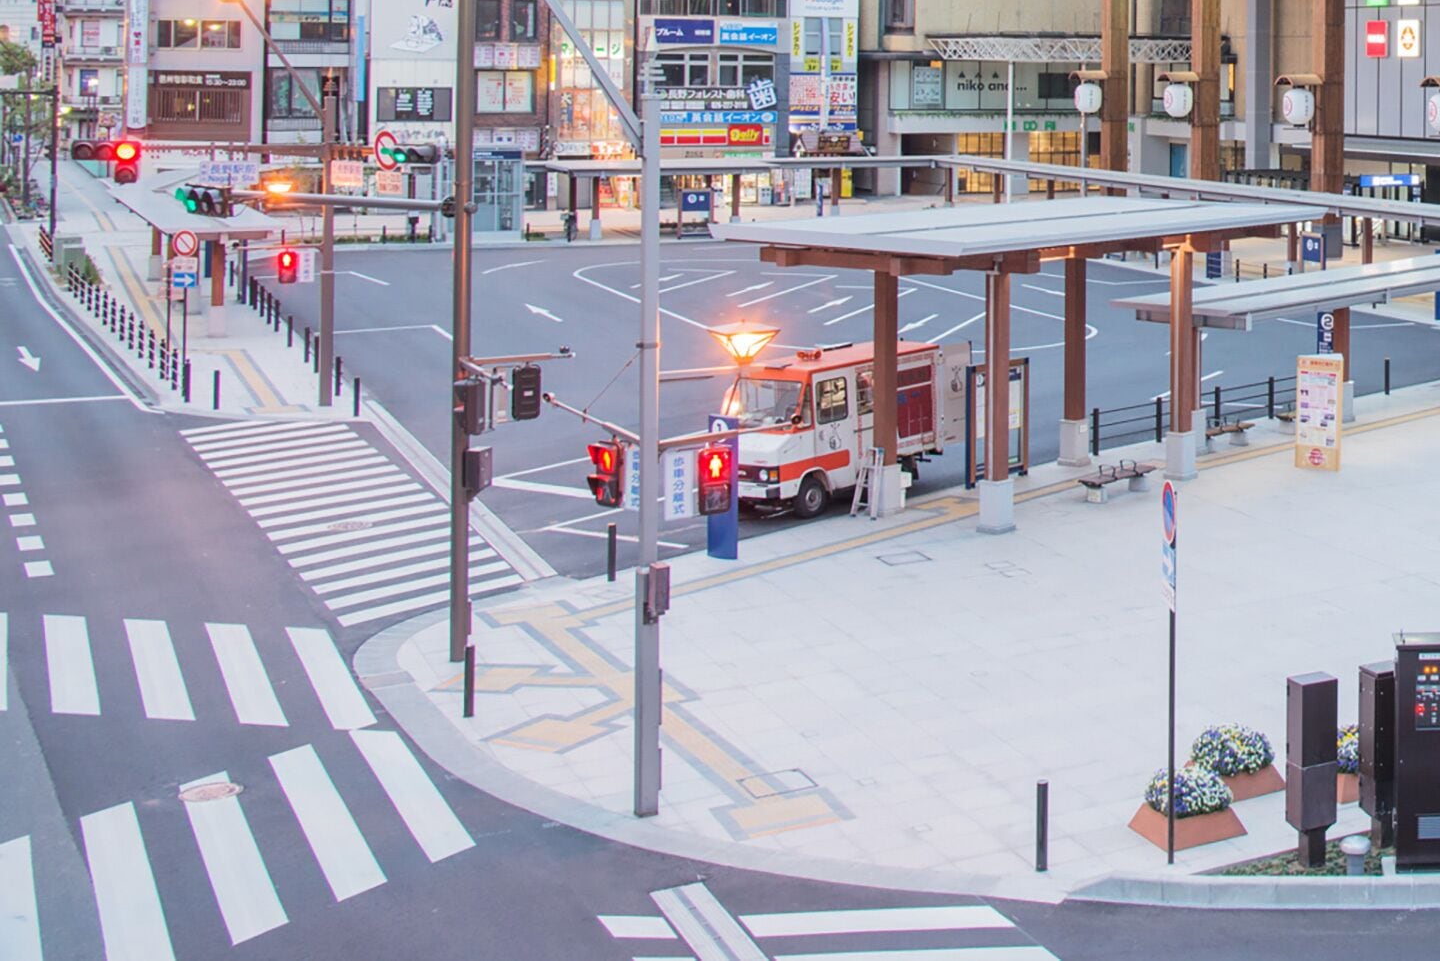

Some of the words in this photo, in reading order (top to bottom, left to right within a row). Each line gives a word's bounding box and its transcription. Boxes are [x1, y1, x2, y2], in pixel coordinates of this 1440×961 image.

[721, 32, 776, 41] 英会話イーオン
[957, 80, 984, 91] niko
[668, 89, 745, 99] 長野フォレスト歯科
[747, 80, 777, 111] 歯
[730, 128, 761, 142] Daily
[208, 175, 238, 183] Nagao
[673, 457, 685, 514] 歩車分離式
